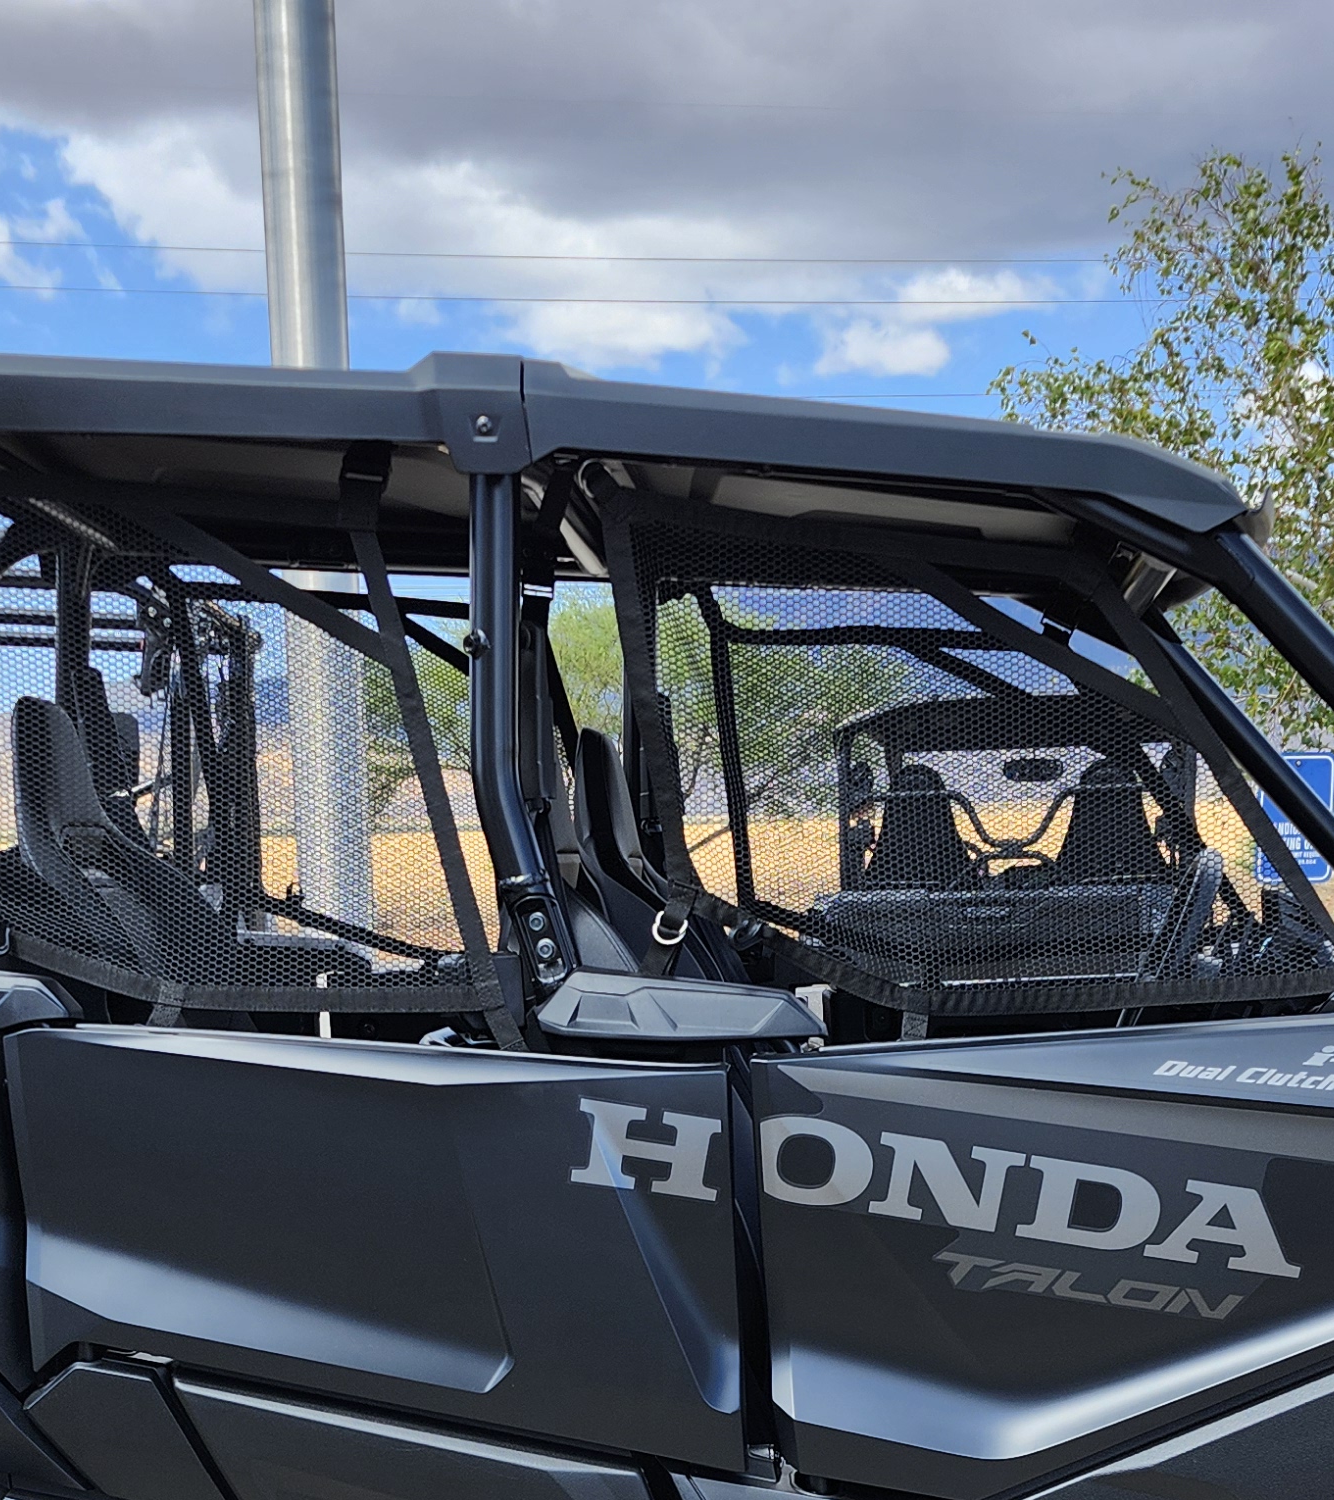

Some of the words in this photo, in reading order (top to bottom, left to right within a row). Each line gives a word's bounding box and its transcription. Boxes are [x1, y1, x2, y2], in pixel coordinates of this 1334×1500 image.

[1153, 1060, 1237, 1081] Dual
[570, 1098, 1302, 1279] HONDA
[933, 1251, 1245, 1320] TALON
